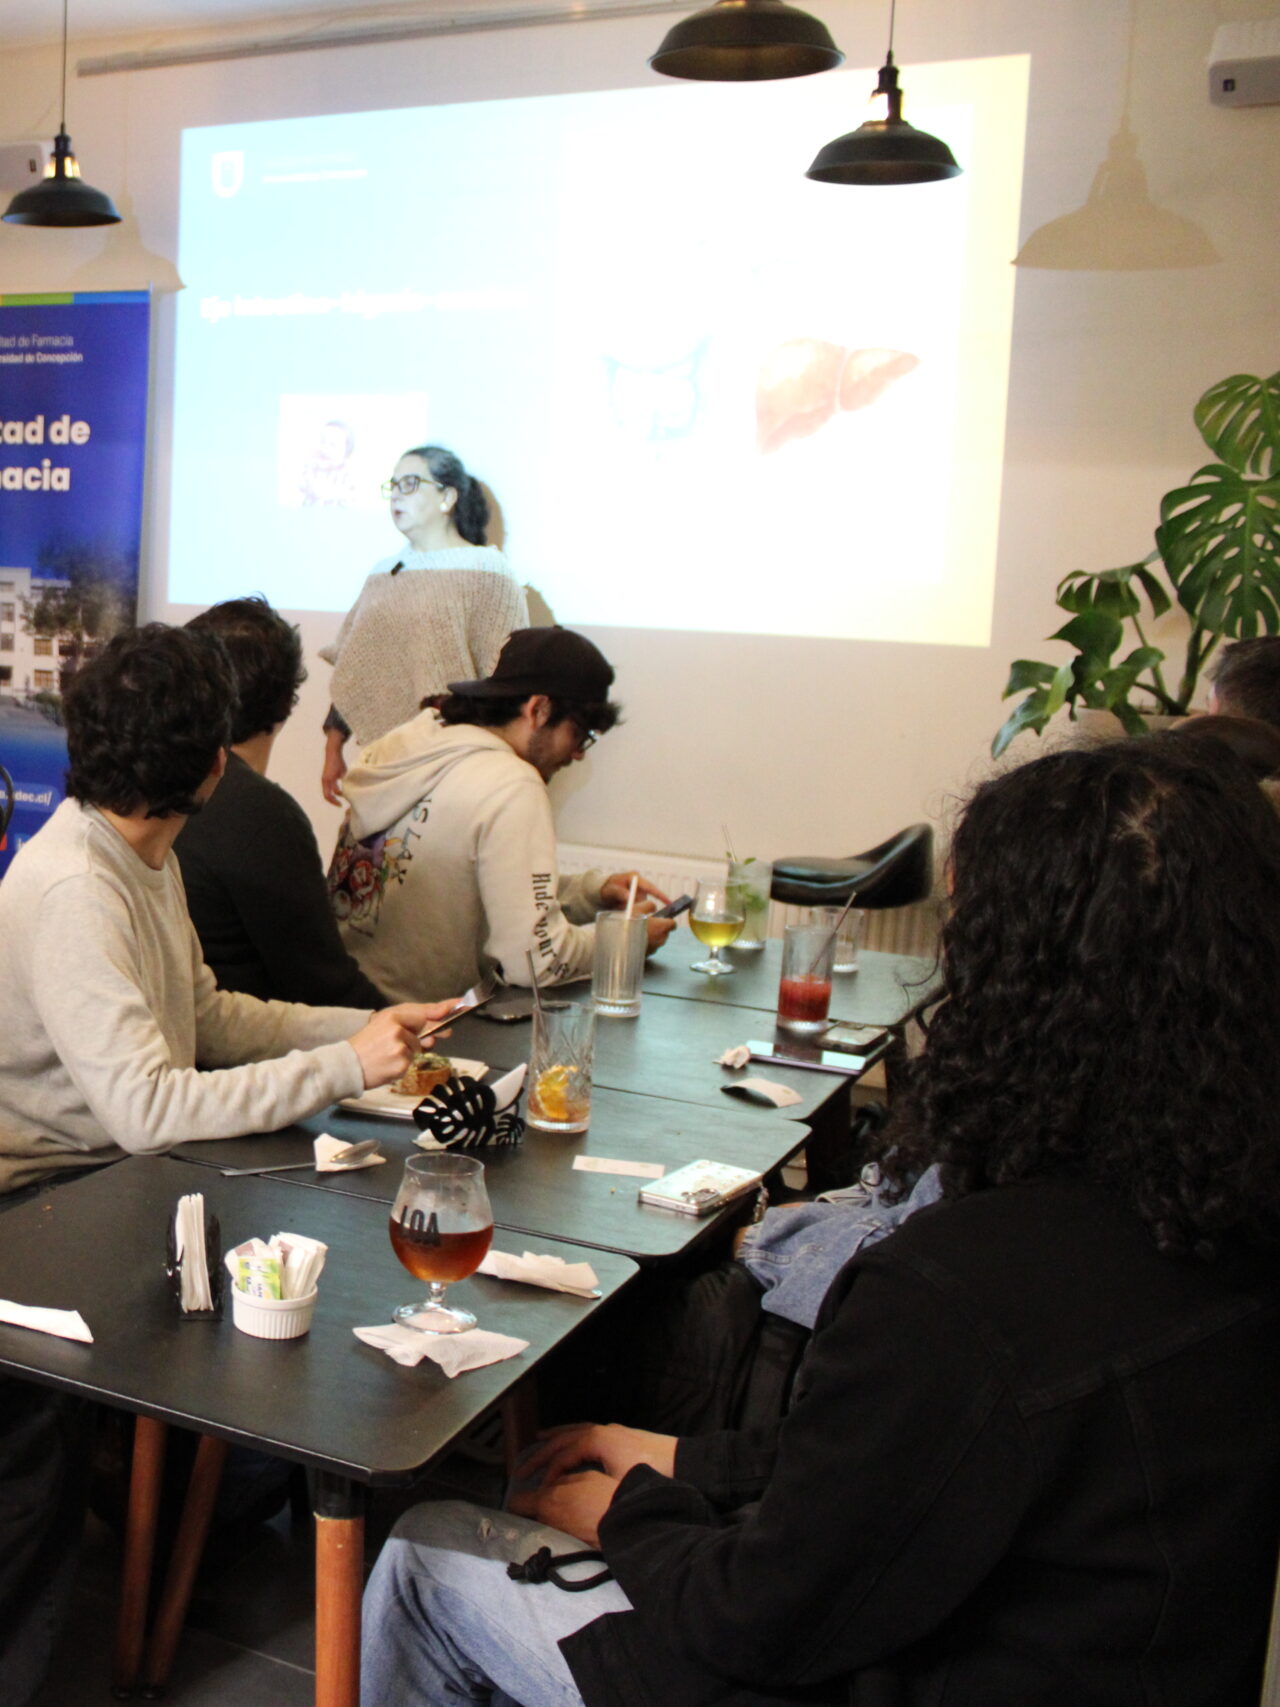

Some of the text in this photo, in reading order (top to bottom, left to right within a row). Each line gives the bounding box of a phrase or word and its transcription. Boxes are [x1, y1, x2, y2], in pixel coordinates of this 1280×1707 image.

[18, 335, 30, 348] de
[32, 333, 74, 347] Farmacia
[25, 352, 35, 363] de
[36, 351, 84, 365] Concepción
[48, 414, 91, 445] de
[531, 873, 554, 911] Hide
